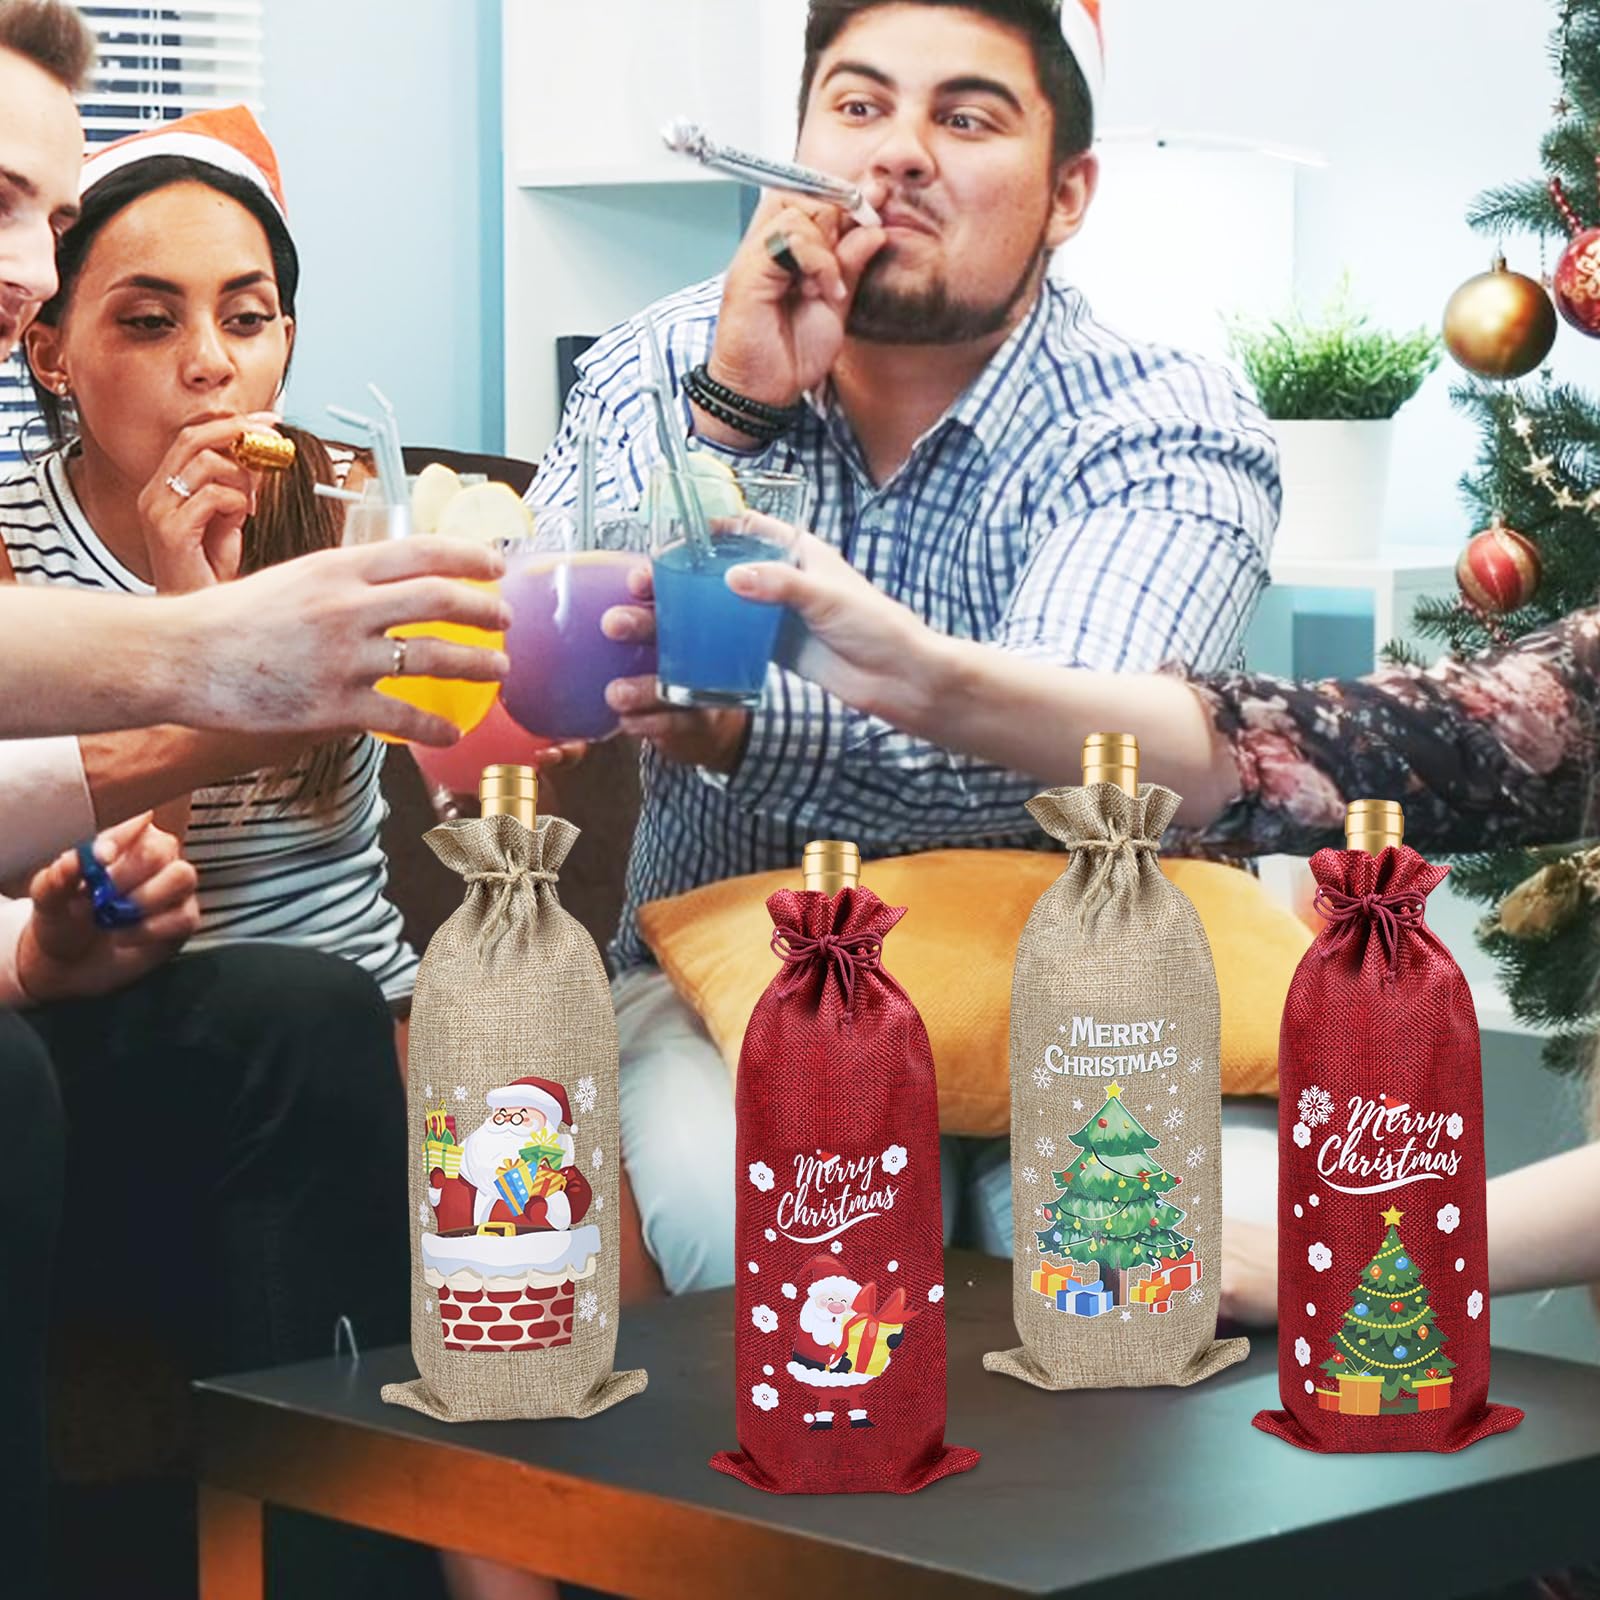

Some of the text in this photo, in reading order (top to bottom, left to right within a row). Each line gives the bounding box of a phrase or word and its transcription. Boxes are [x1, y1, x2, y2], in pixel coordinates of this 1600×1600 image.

[1070, 1016, 1166, 1048] MERRY
[1044, 1044, 1179, 1077] CHRISTMAS
[1347, 1095, 1449, 1149] Merry
[793, 1153, 880, 1193] Merry
[1317, 1126, 1462, 1180] Christmas
[777, 1182, 899, 1229] Christmas
